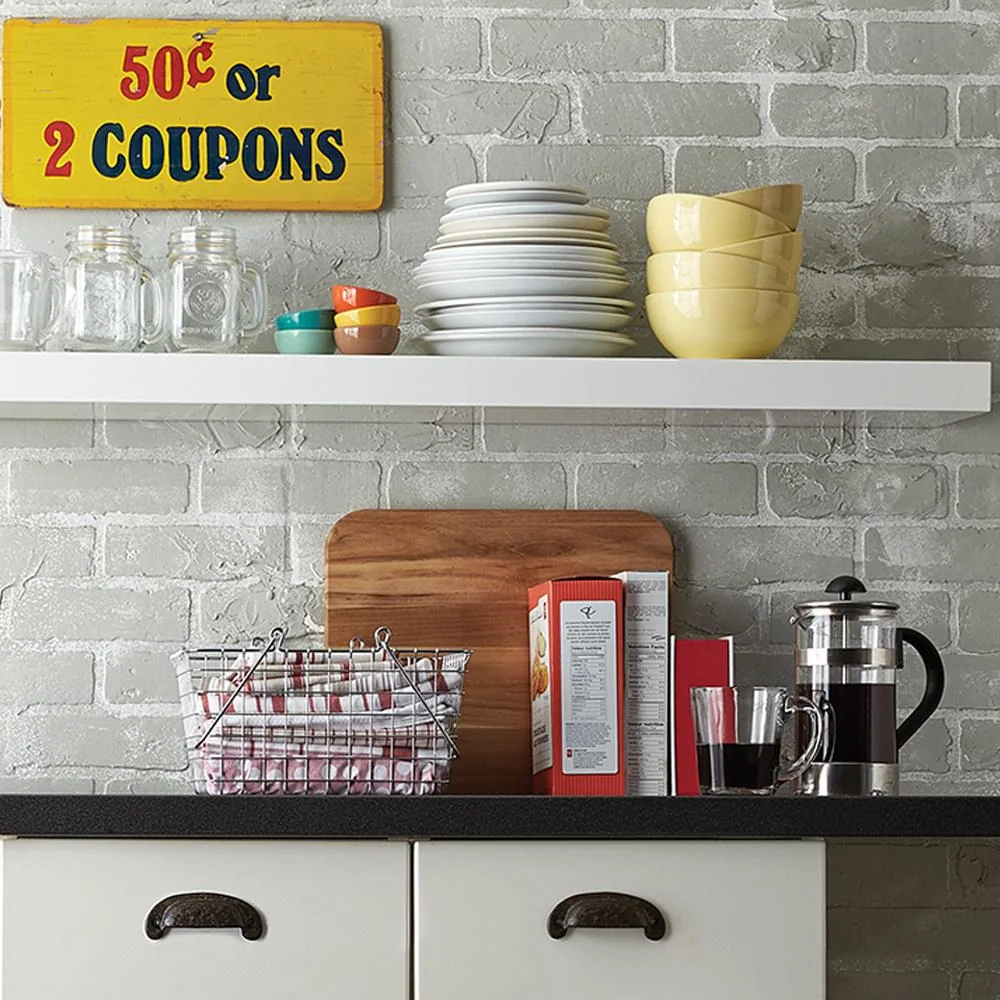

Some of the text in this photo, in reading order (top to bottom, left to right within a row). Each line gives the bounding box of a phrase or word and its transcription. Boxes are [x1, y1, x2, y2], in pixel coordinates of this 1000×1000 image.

[120, 41, 280, 101] 50¢ or
[44, 121, 345, 181] 2 COUPONS
